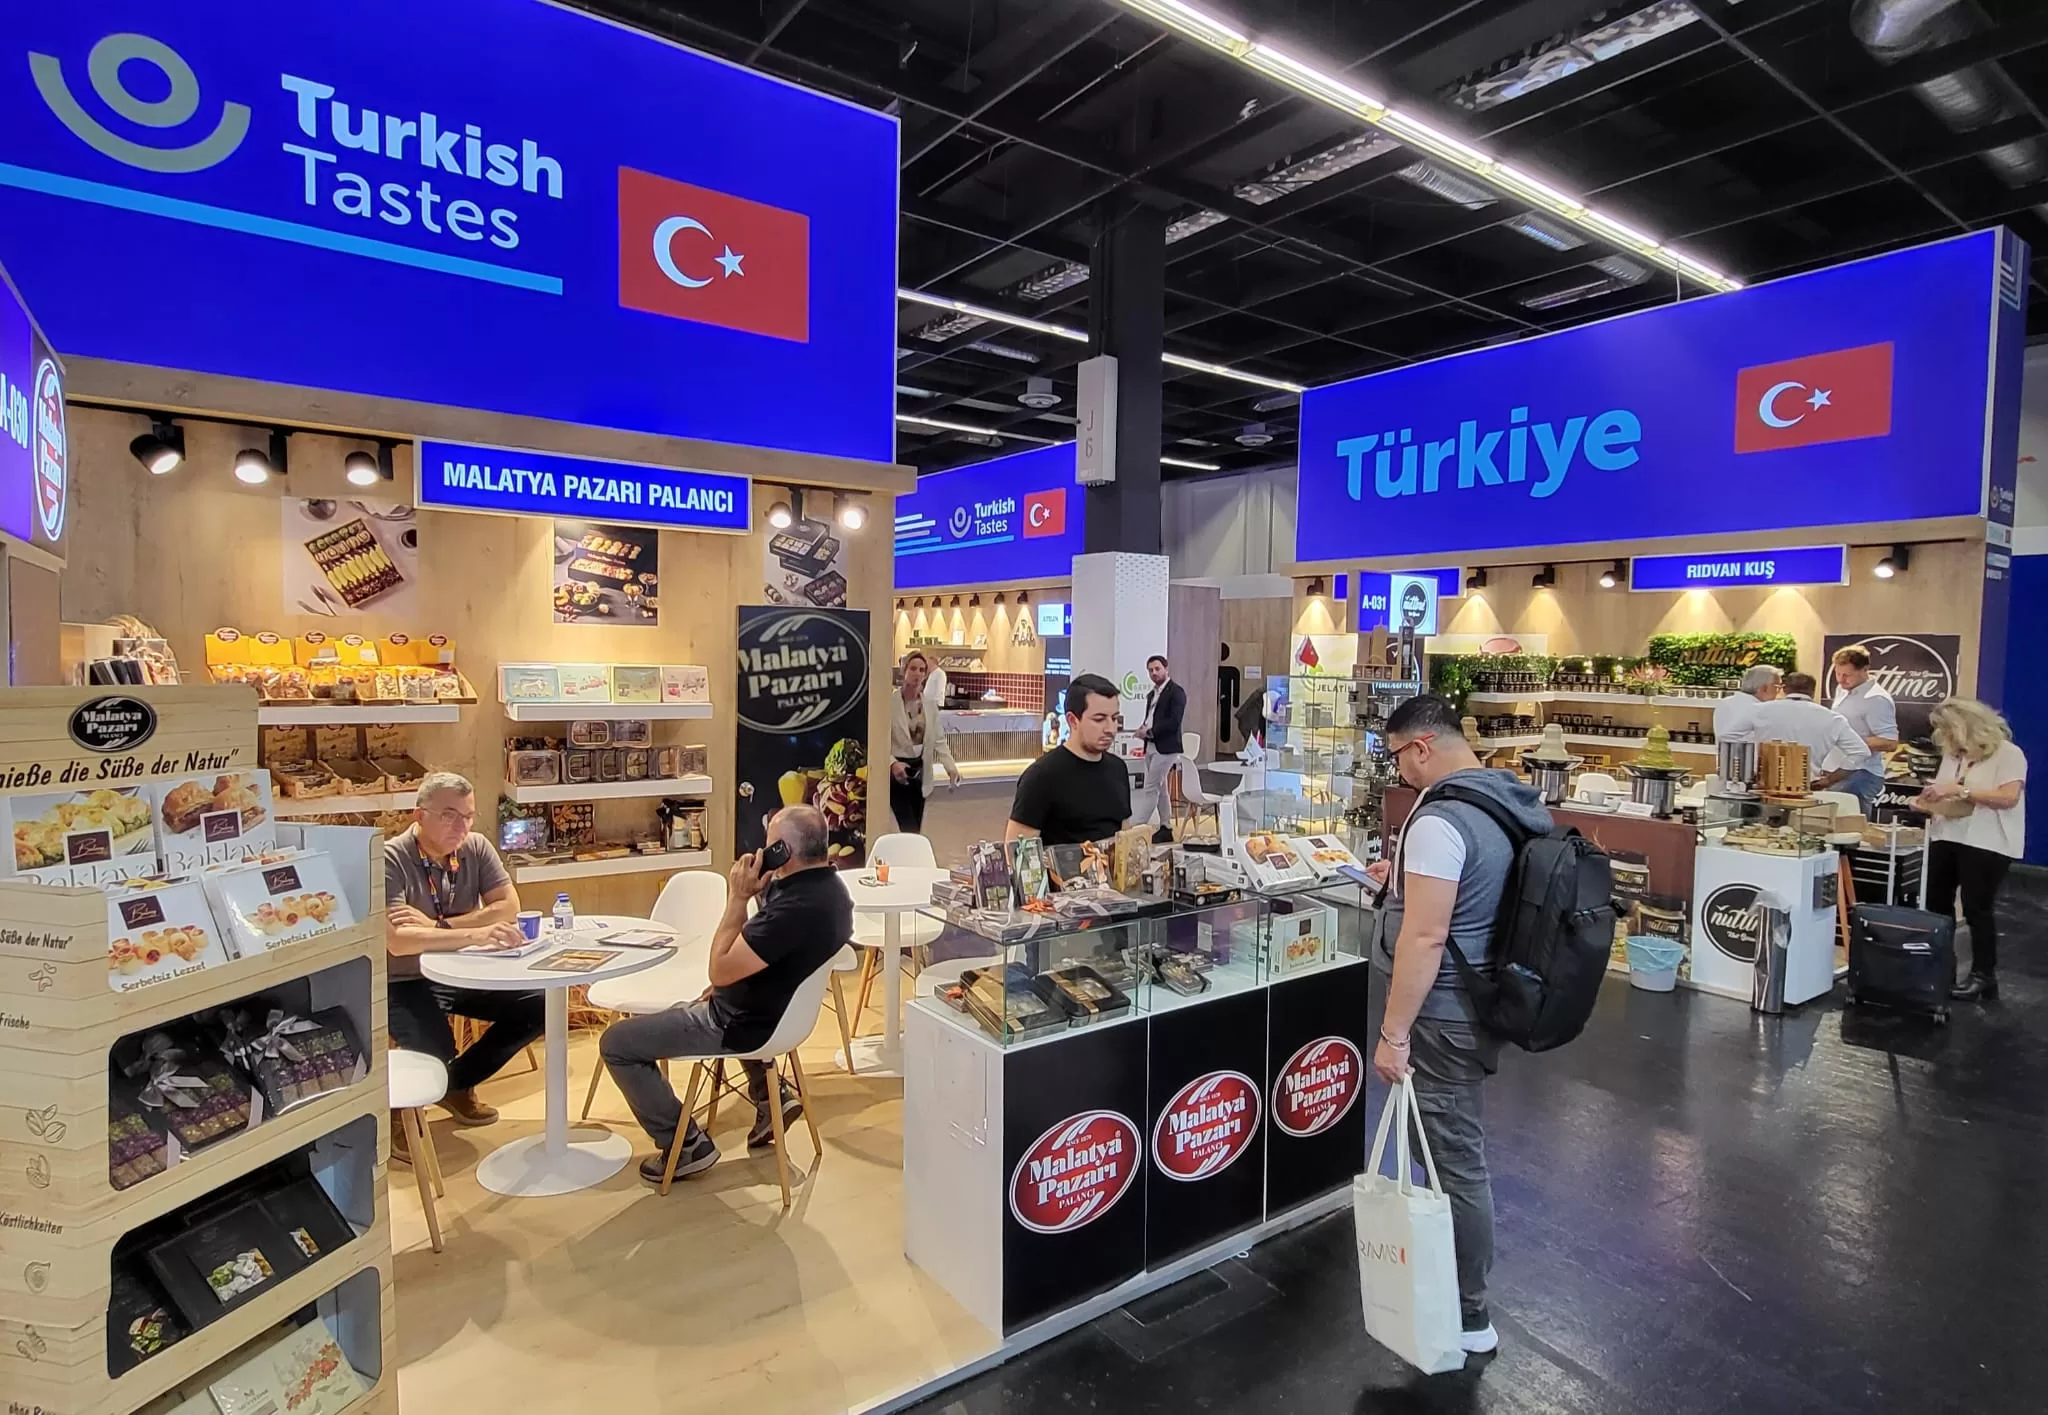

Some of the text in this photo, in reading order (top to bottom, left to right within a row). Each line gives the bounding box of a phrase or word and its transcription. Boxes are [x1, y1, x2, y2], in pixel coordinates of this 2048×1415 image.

[281, 73, 563, 200] Turkish
[282, 142, 520, 249] Tastes
[1086, 409, 1094, 432] J
[1085, 437, 1094, 458] 6
[1336, 406, 1642, 501] Türkiye
[443, 462, 733, 513] MALATYA PAZARI PALANCI
[974, 497, 1016, 519] Turkish
[974, 518, 1008, 536] Tastes
[1687, 560, 1775, 579] RIDVAN KUŞ
[1362, 595, 1387, 611] A-031
[748, 671, 843, 699] Pazarı
[81, 709, 142, 724] Malatya
[86, 722, 138, 735] Pazarı
[59, 761, 89, 783] die
[96, 756, 145, 781] Süße
[150, 753, 179, 775] der
[25, 931, 40, 947] der
[309, 923, 337, 938] Lezzet
[121, 961, 206, 992] Serbetsiz Lezzet
[1285, 1060, 1349, 1095] Malatya
[1291, 1080, 1346, 1112] Pazarı
[1168, 1097, 1246, 1135] Malatya
[1175, 1118, 1240, 1155] Pazarı
[1192, 1141, 1224, 1160] PALANCI
[1029, 1138, 1122, 1184] Malatya
[1037, 1162, 1117, 1206] Pazarı
[1059, 1188, 1097, 1209] PALANCI
